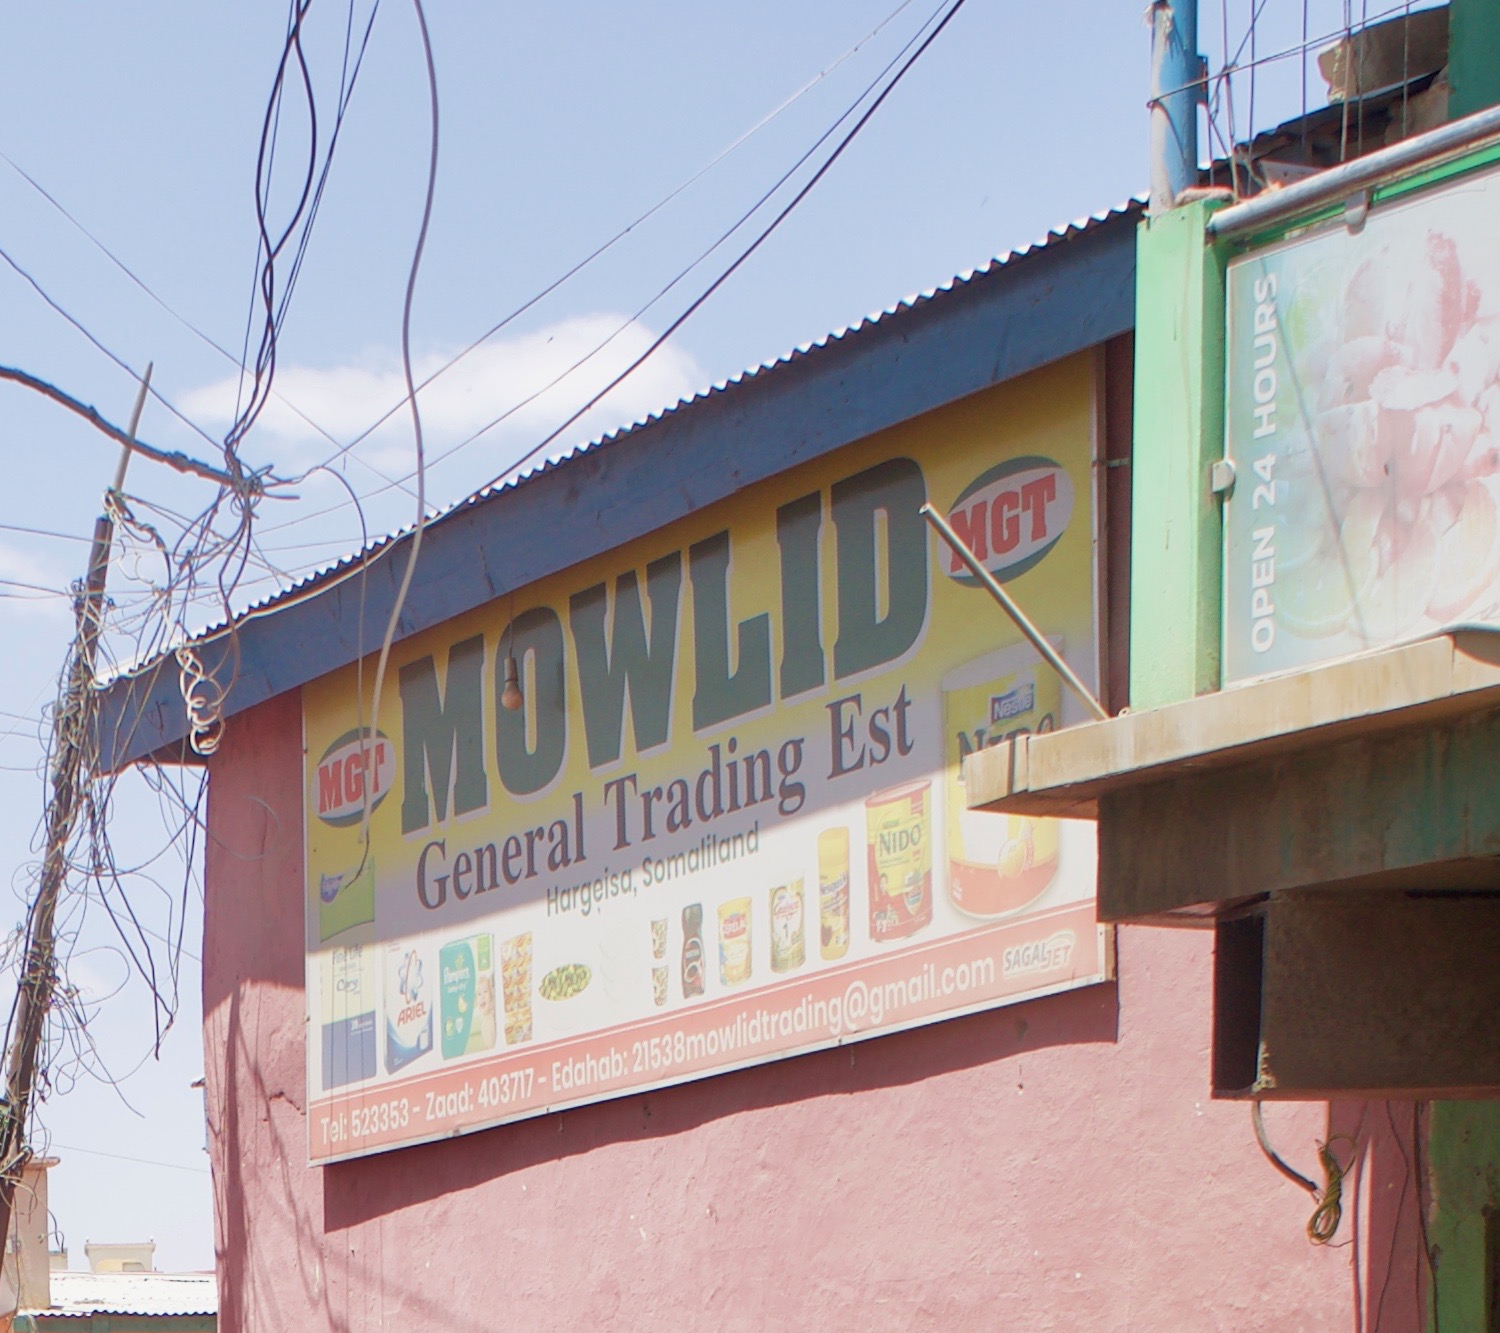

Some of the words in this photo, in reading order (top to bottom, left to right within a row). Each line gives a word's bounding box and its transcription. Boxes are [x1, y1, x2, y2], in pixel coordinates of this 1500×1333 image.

[1253, 272, 1278, 439] HOURS
[950, 473, 1056, 573] MGT
[1252, 453, 1277, 510] 24
[1251, 525, 1275, 653] OPEN
[399, 457, 930, 836] MOWLID
[318, 743, 385, 814] MGT
[416, 790, 587, 912] General
[603, 732, 807, 853] Trading
[824, 683, 915, 781] Est
[547, 866, 637, 917] Hargeisa,
[643, 820, 760, 888] Somaliland
[880, 824, 921, 858] NIDO
[397, 1001, 427, 1028] ARIEL
[319, 1111, 348, 1146] Tel:
[350, 1098, 409, 1138] 523353
[425, 1085, 474, 1122] Zaad:
[477, 1067, 534, 1109] 403717
[551, 1048, 627, 1093] Edahab:
